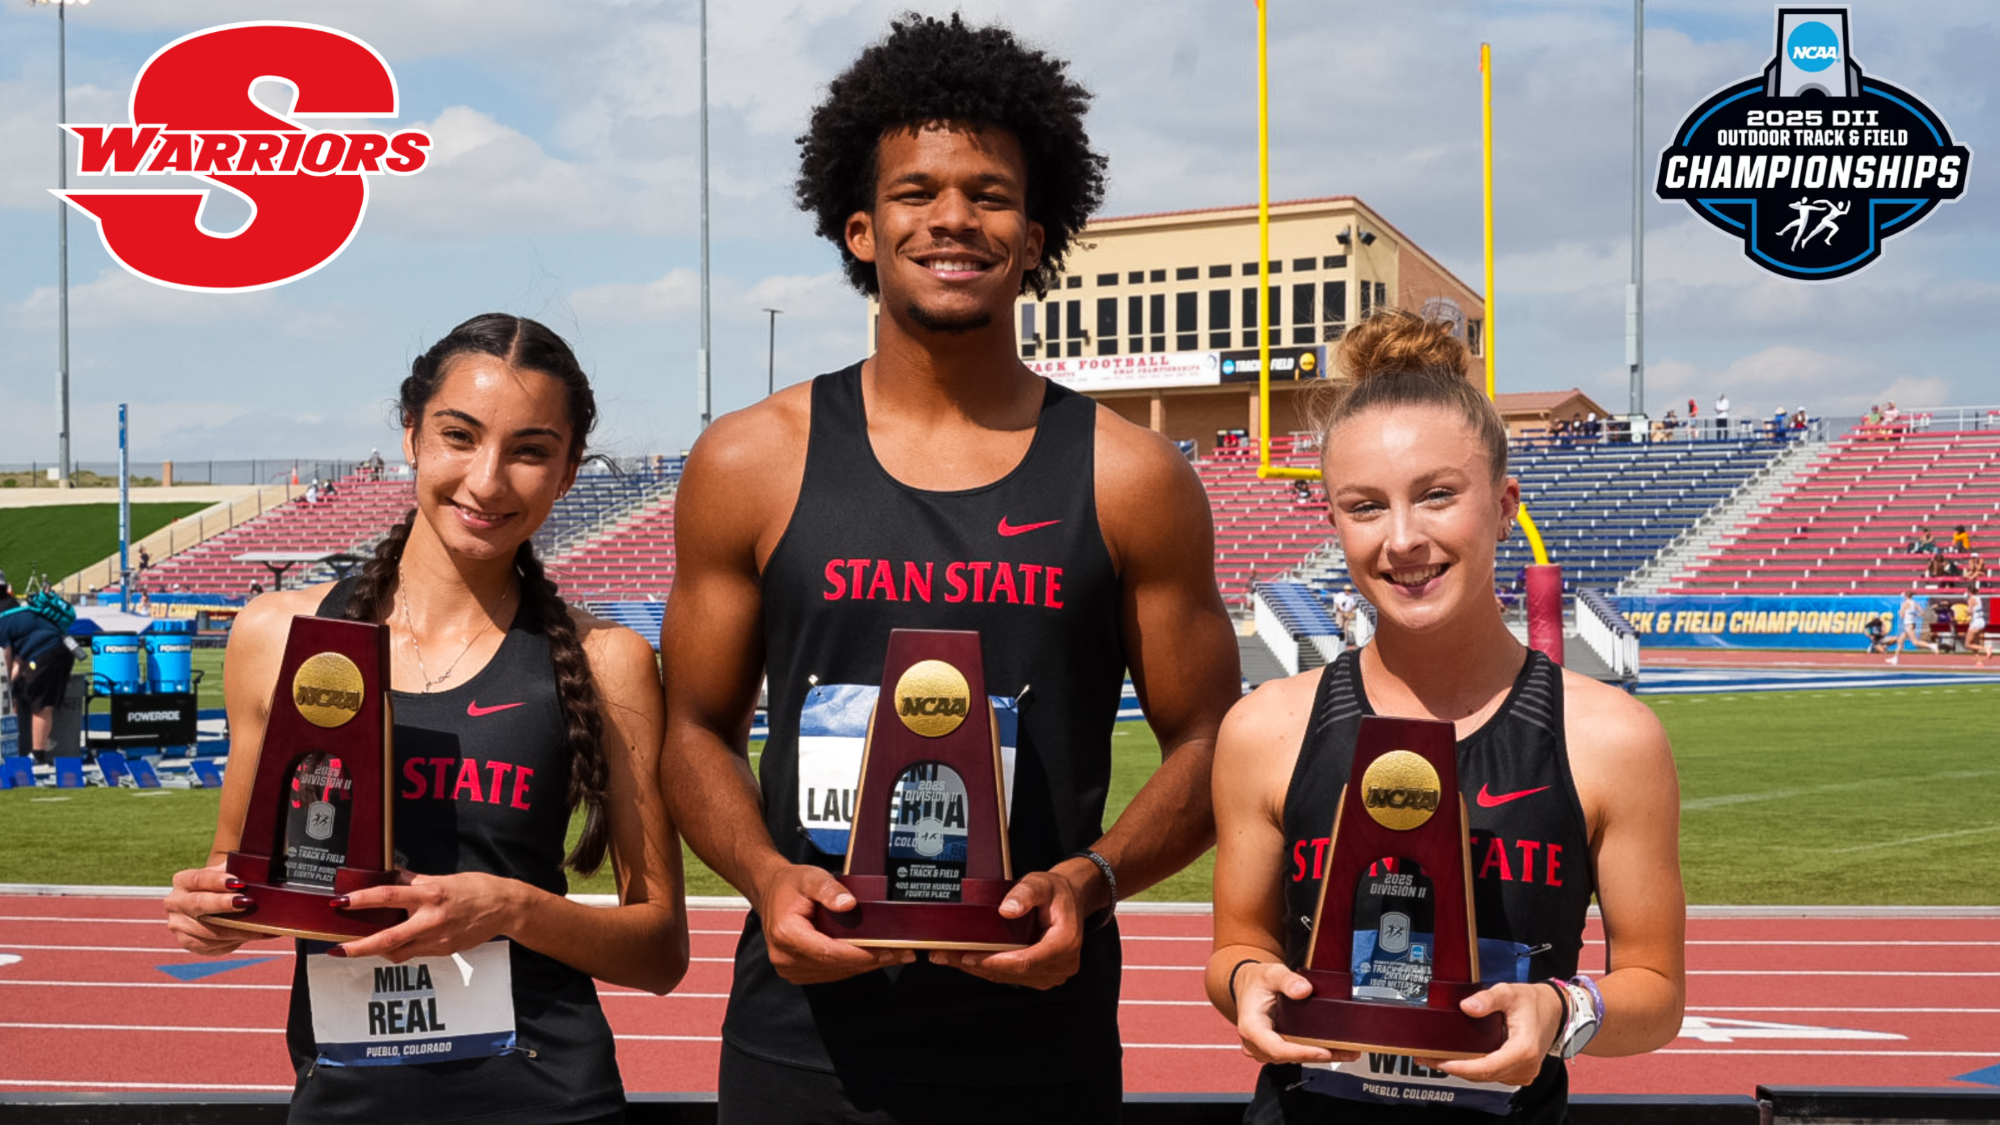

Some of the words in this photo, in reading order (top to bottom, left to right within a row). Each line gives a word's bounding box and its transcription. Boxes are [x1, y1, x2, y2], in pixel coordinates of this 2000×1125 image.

[1079, 356, 1169, 370] FOOTBALL
[823, 559, 934, 603] STAN
[944, 561, 1064, 609] STATE
[1656, 611, 1672, 634] &
[1674, 611, 1726, 634] FIELD
[296, 685, 361, 712] NCAA
[901, 696, 967, 717] NCAA
[127, 711, 181, 722] POWERADE
[301, 774, 343, 789] DIVISION
[401, 757, 534, 811] STATE
[918, 780, 946, 790] 2025
[1366, 787, 1439, 812] NCAA
[298, 849, 319, 860] TRACK
[326, 854, 346, 864] FIELD
[909, 868, 932, 878] TRACK
[939, 869, 960, 878] FIELD
[1384, 873, 1414, 886] 2025
[930, 891, 951, 899] PLACE
[1370, 883, 1417, 898] DIVISION
[1417, 887, 1427, 899] II
[374, 964, 434, 993] MILA
[368, 997, 446, 1036] REAL
[366, 1045, 401, 1058] PUEBLO,
[403, 1041, 452, 1055] COLORADO
[1362, 1083, 1400, 1099] PUEBLO,
[1402, 1088, 1455, 1102] COLORADO
